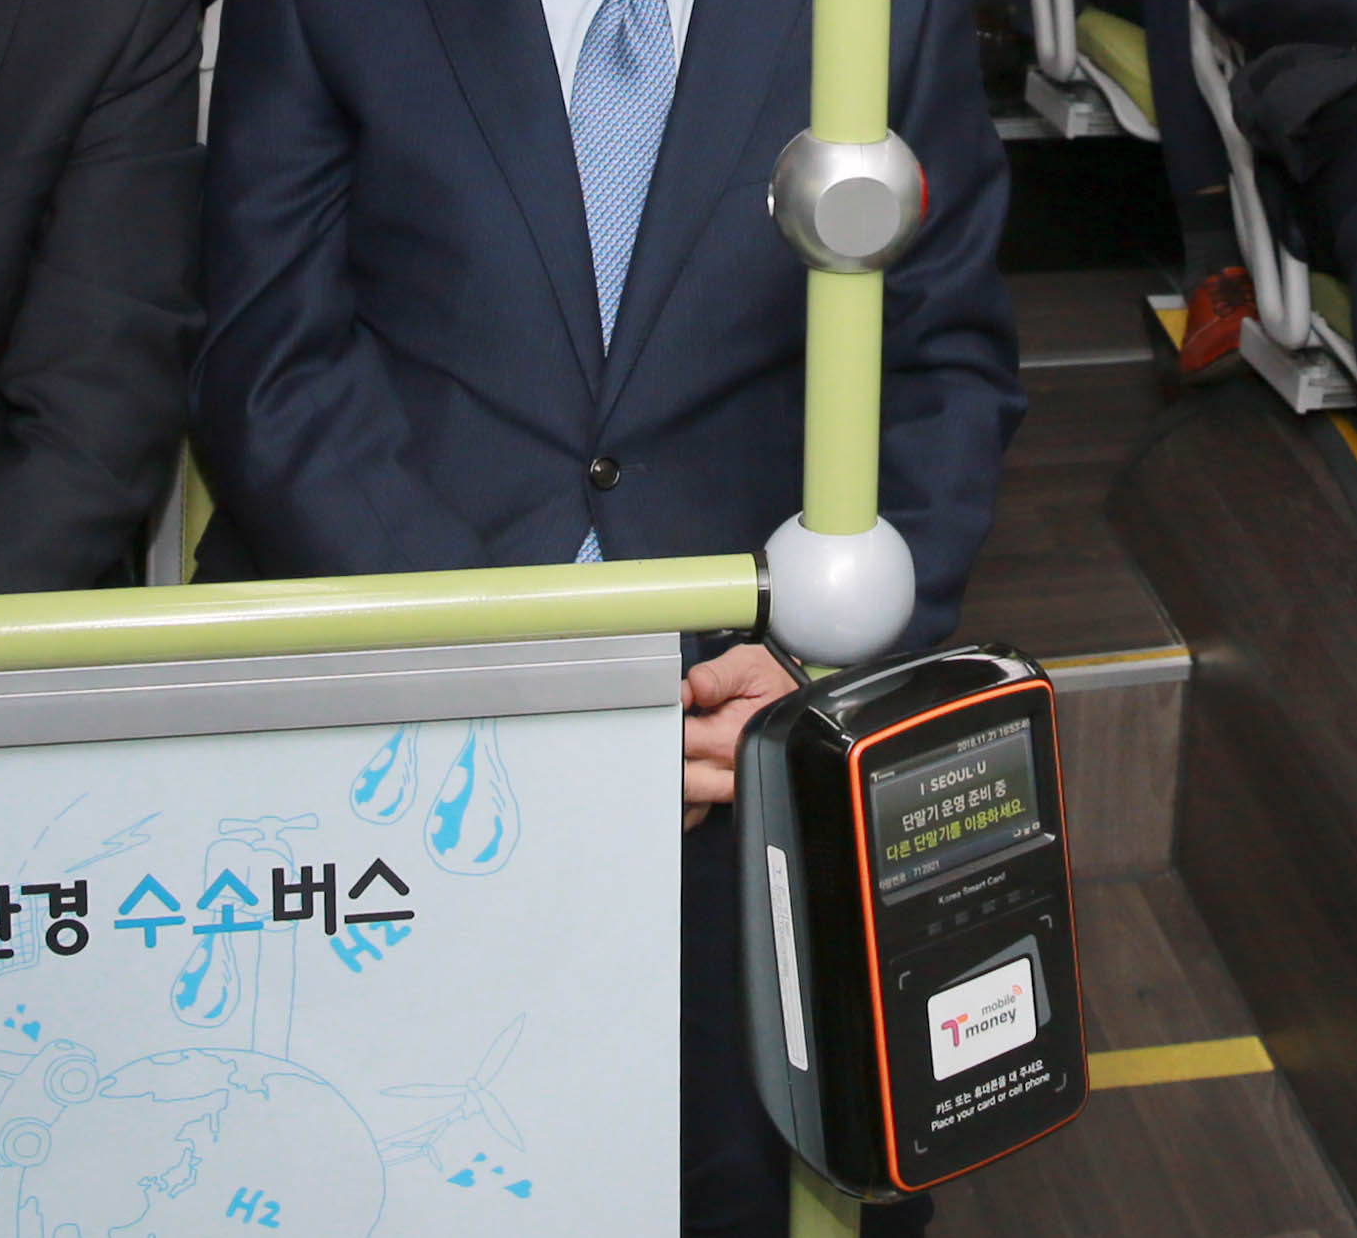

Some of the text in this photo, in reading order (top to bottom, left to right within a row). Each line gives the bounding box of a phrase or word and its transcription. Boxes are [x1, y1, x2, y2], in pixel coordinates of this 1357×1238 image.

[902, 779, 1007, 832] 단말기 운영 준비 중
[886, 841, 911, 861] 다른
[914, 821, 962, 852] 단말기를
[114, 857, 416, 949] 수소버스
[330, 921, 413, 974] H2
[981, 994, 1016, 1016] mobile
[931, 1073, 1051, 1132] Place your card or cell phone
[936, 1098, 953, 1115] 카드
[955, 1091, 972, 1106] 또는
[225, 1186, 281, 1229] H2
